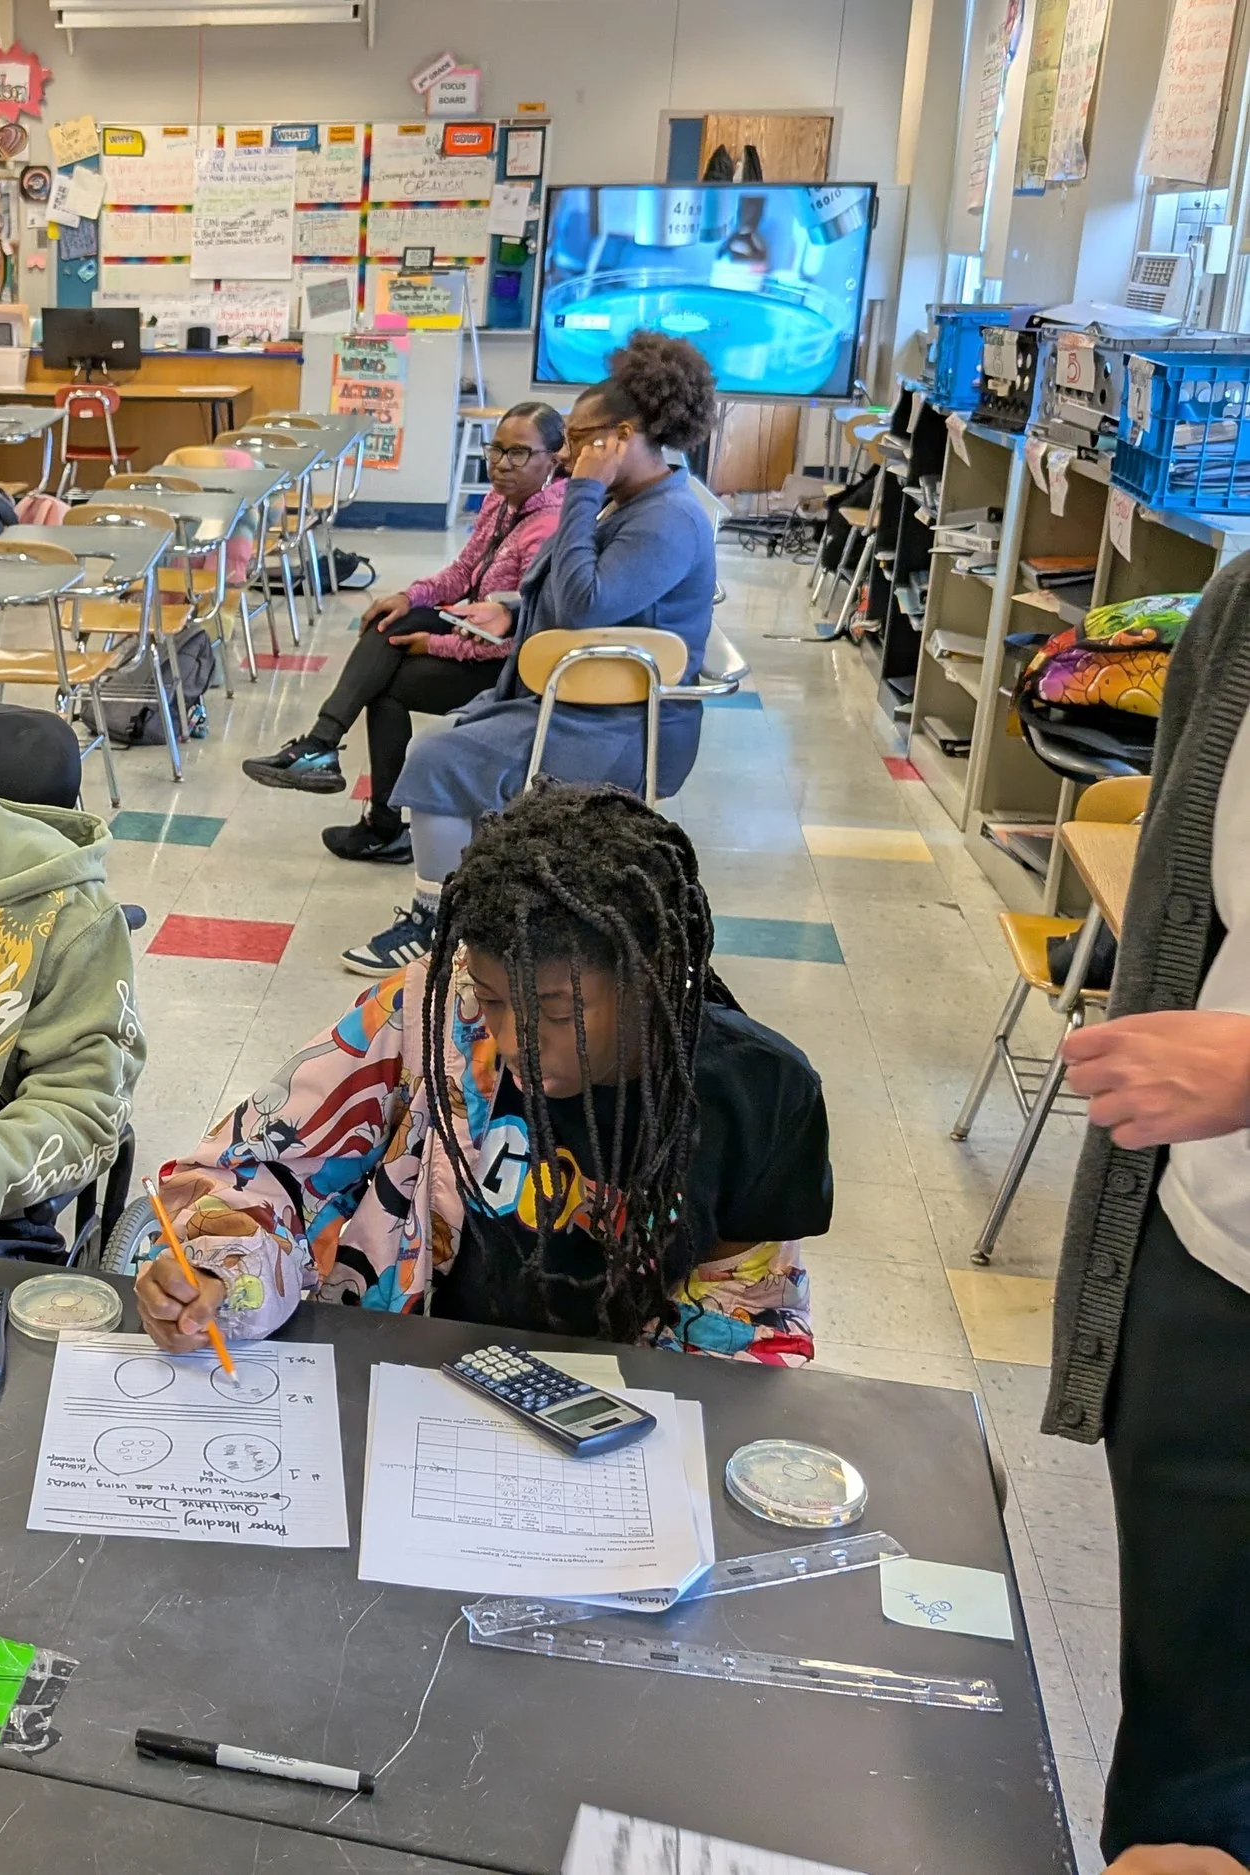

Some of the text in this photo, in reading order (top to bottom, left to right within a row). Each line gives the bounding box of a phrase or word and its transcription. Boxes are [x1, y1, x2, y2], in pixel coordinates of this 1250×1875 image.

[440, 82, 466, 91] FOCUS
[438, 96, 466, 104] BOARD
[109, 135, 135, 144] WHY?
[277, 130, 312, 141] WHAT?
[1067, 353, 1079, 383] 5
[286, 1393, 300, 1403] 2
[288, 1468, 301, 1481] 1
[96, 1478, 127, 1490] using
[134, 1483, 153, 1491] see
[158, 1482, 177, 1493] you
[181, 1486, 212, 1499] what
[218, 1487, 269, 1500] describe
[128, 1497, 259, 1517] Qualitative Data
[183, 1509, 241, 1535] Heading
[246, 1520, 289, 1538] Proper
[460, 1549, 500, 1558] Experiment
[501, 1553, 551, 1562] Predator-Prey
